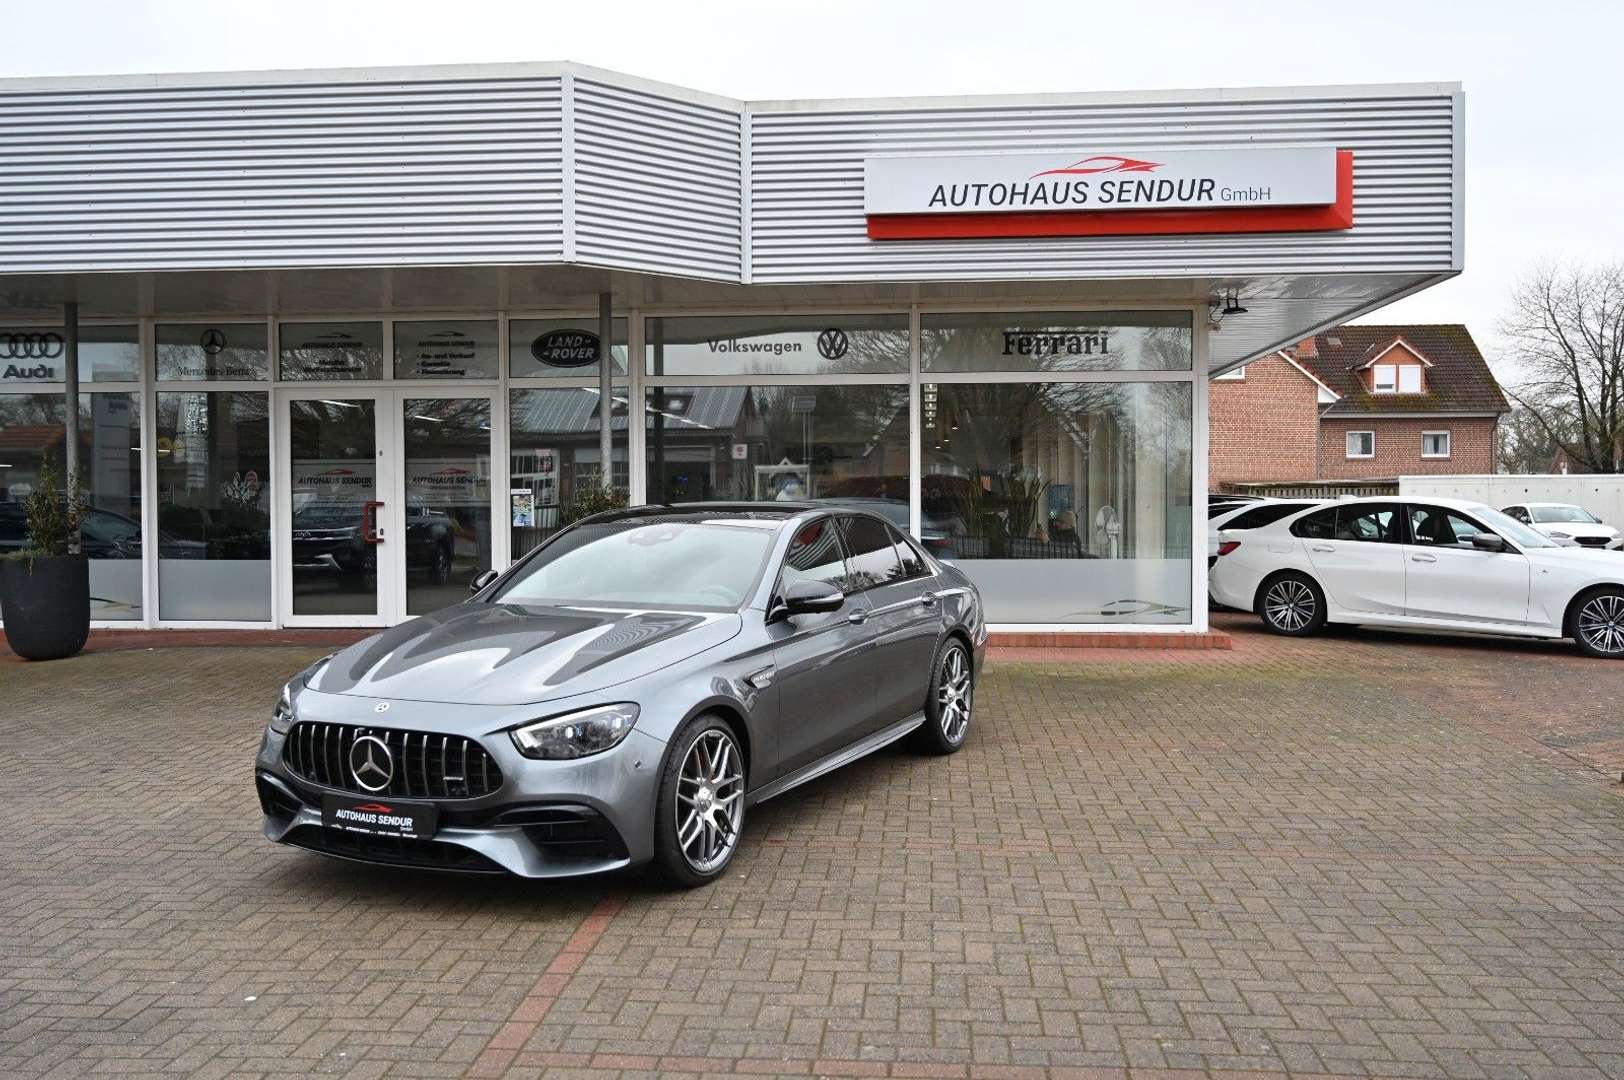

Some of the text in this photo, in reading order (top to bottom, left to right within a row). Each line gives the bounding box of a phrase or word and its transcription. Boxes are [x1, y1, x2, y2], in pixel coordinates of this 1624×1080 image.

[928, 178, 1271, 207] AUTOHAUS SENDUR GmbH
[708, 339, 802, 355] Volkswagen
[1002, 331, 1109, 355] Ferrari
[2, 364, 55, 379] Audi
[341, 477, 373, 485] SENDUR
[336, 809, 414, 827] AUTOHAUS SENDUR
